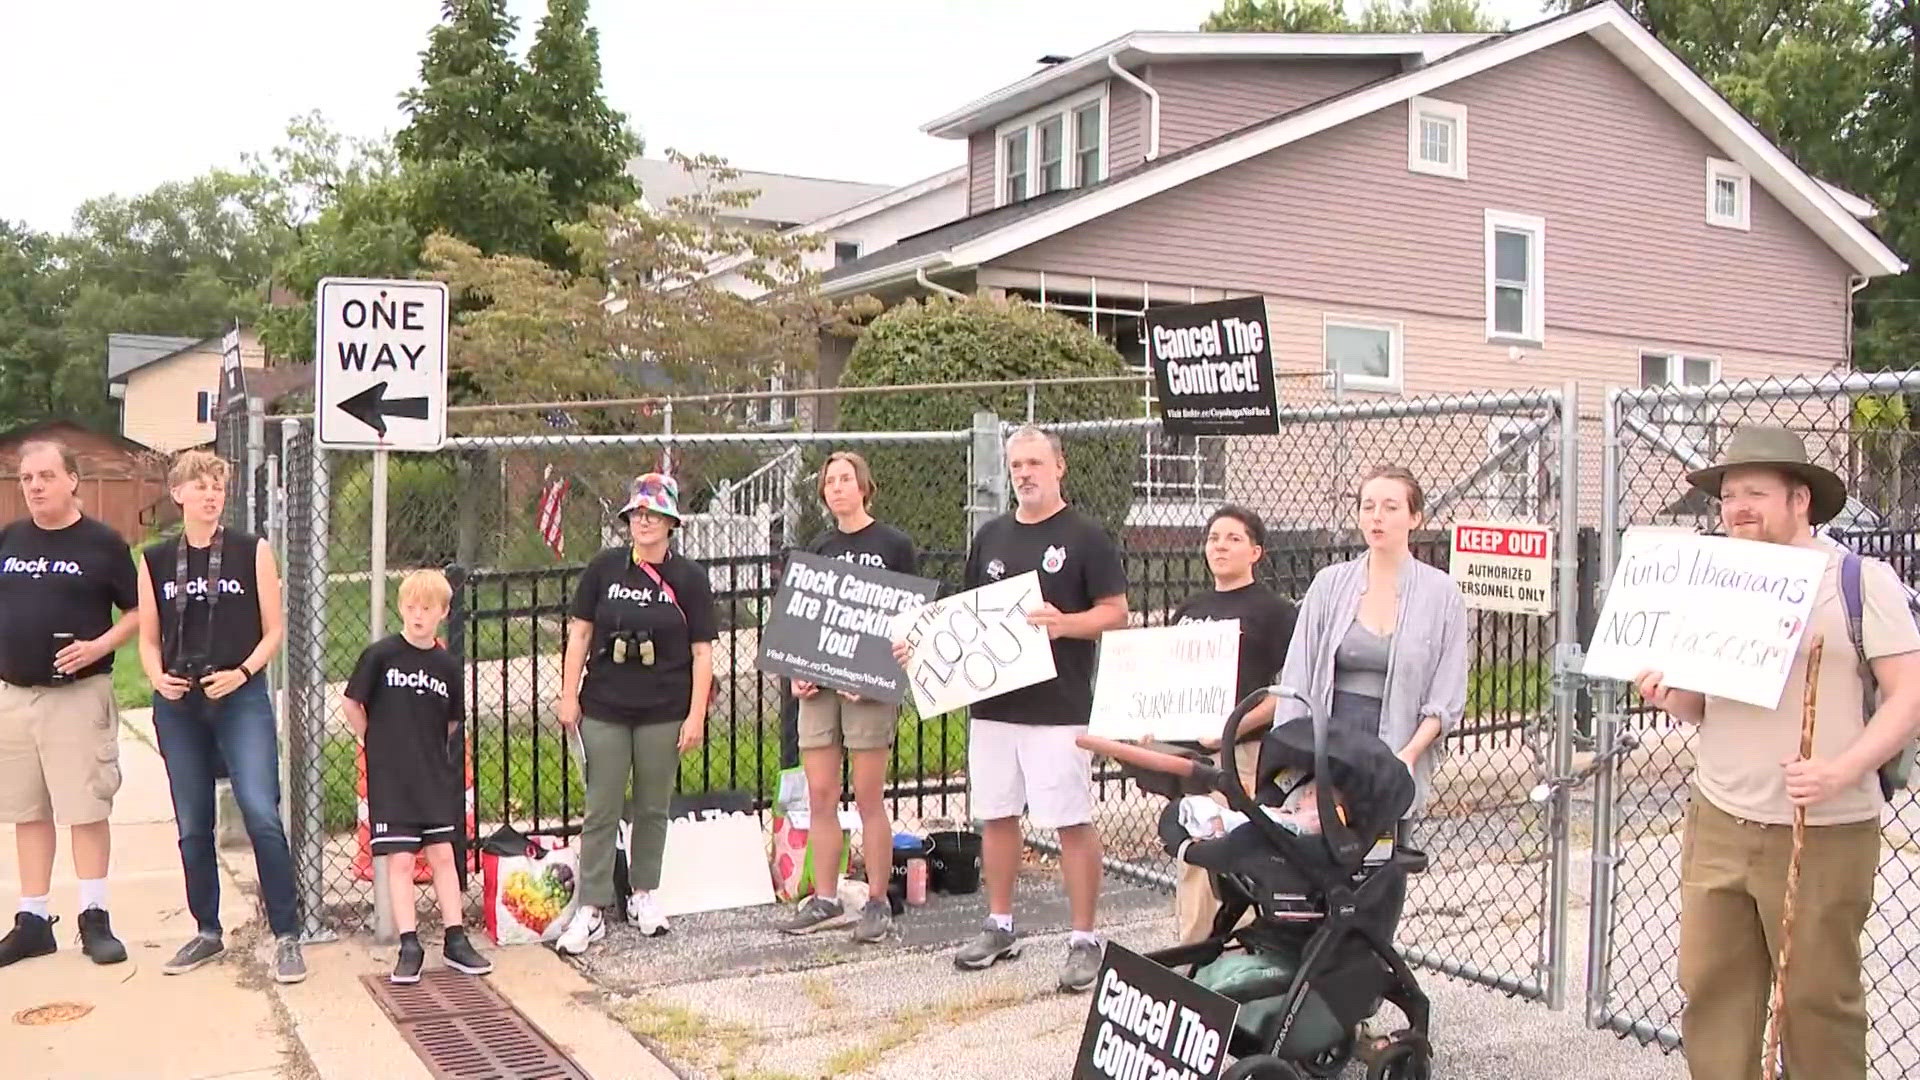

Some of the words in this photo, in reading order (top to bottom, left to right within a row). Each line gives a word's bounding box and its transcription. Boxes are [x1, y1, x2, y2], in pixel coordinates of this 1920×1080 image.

[342, 299, 424, 330] ONE
[1153, 320, 1222, 360] Cancel
[1222, 317, 1264, 355] The
[338, 342, 426, 371] WAY
[1167, 355, 1260, 395] Contract!
[1460, 529, 1503, 553] KEEP
[1508, 532, 1545, 556] OUT
[3, 557, 49, 573] flock
[52, 559, 84, 576] no.
[859, 552, 887, 569] no.
[1468, 563, 1532, 581] AUTHORIZED
[607, 583, 653, 602] flock
[785, 562, 840, 597] Flock
[839, 574, 926, 612] Cameras
[1518, 587, 1545, 602] ONLY
[786, 591, 821, 621] Are
[822, 598, 895, 640] Trackin
[919, 601, 947, 626] THE
[1603, 610, 1670, 648] NOT
[817, 625, 860, 659] You!
[914, 590, 1005, 706] FLOCK
[964, 589, 1040, 692] OUT
[386, 667, 430, 688] flock
[430, 677, 449, 698] no.
[1097, 967, 1177, 1050] Cancel
[1172, 1005, 1221, 1075] The
